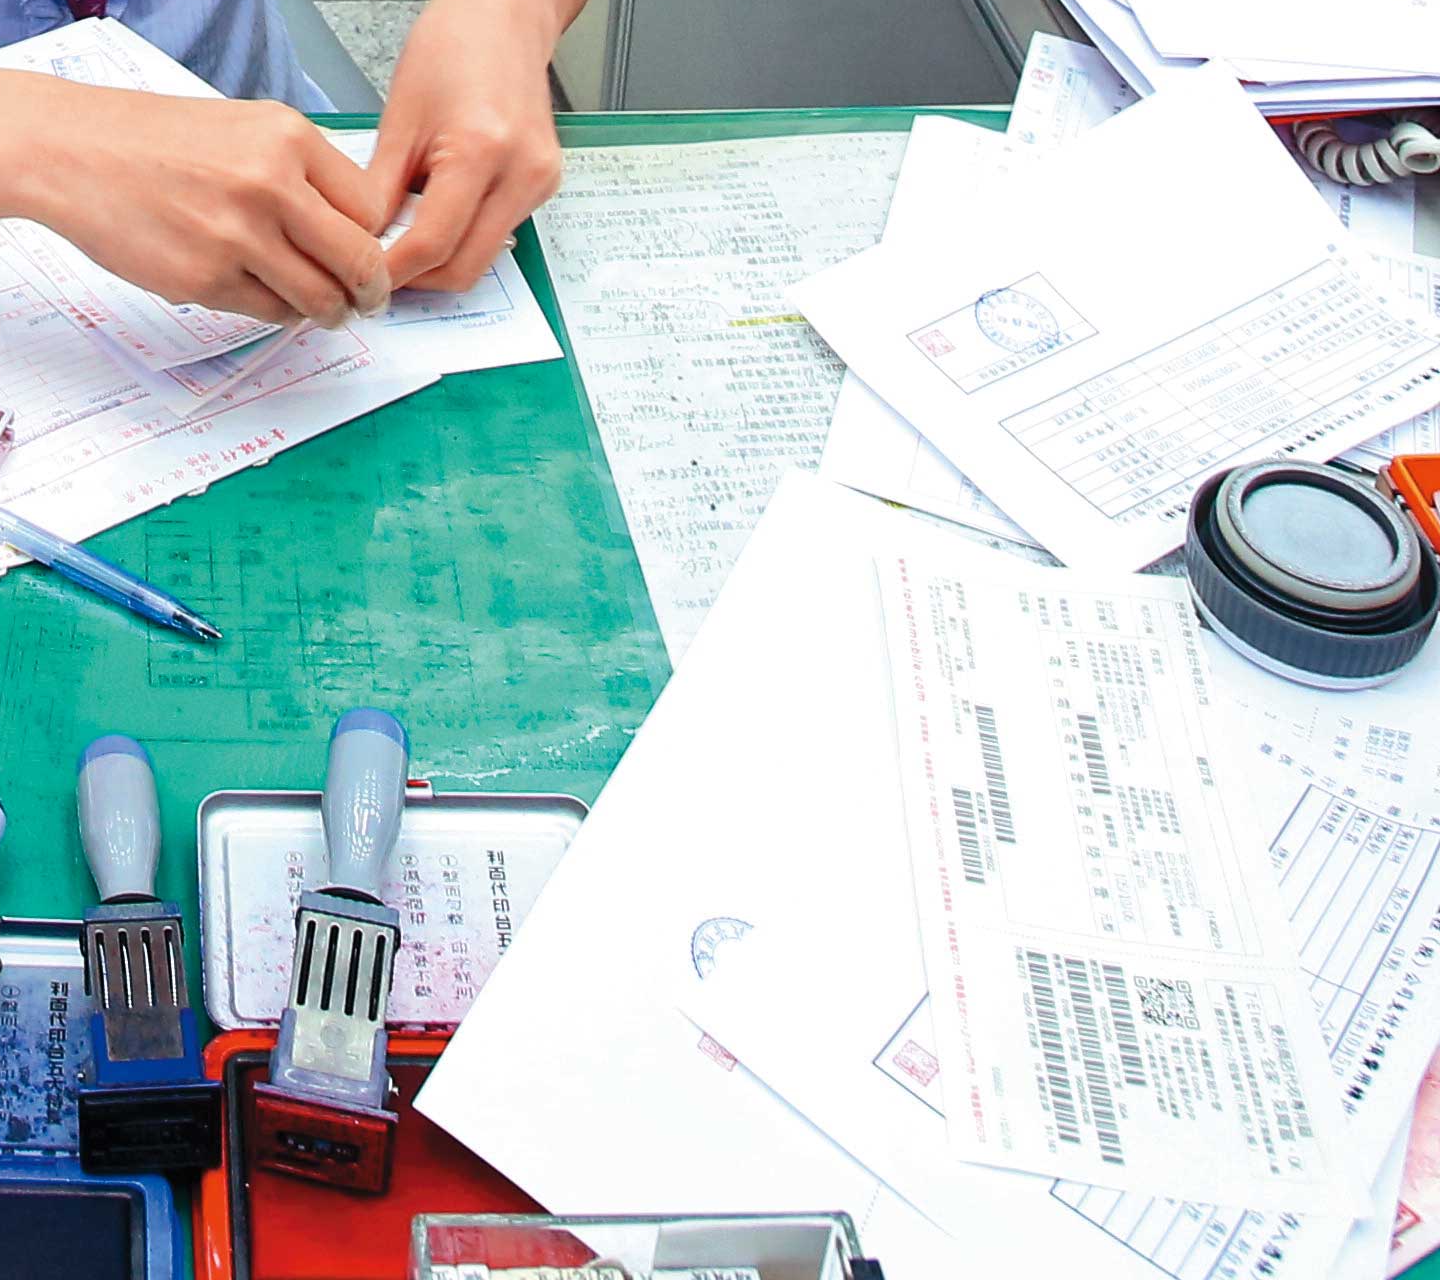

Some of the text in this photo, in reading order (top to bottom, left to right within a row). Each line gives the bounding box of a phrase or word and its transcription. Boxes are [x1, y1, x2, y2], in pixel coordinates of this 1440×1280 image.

[485, 850, 513, 956] 利百代印台五
